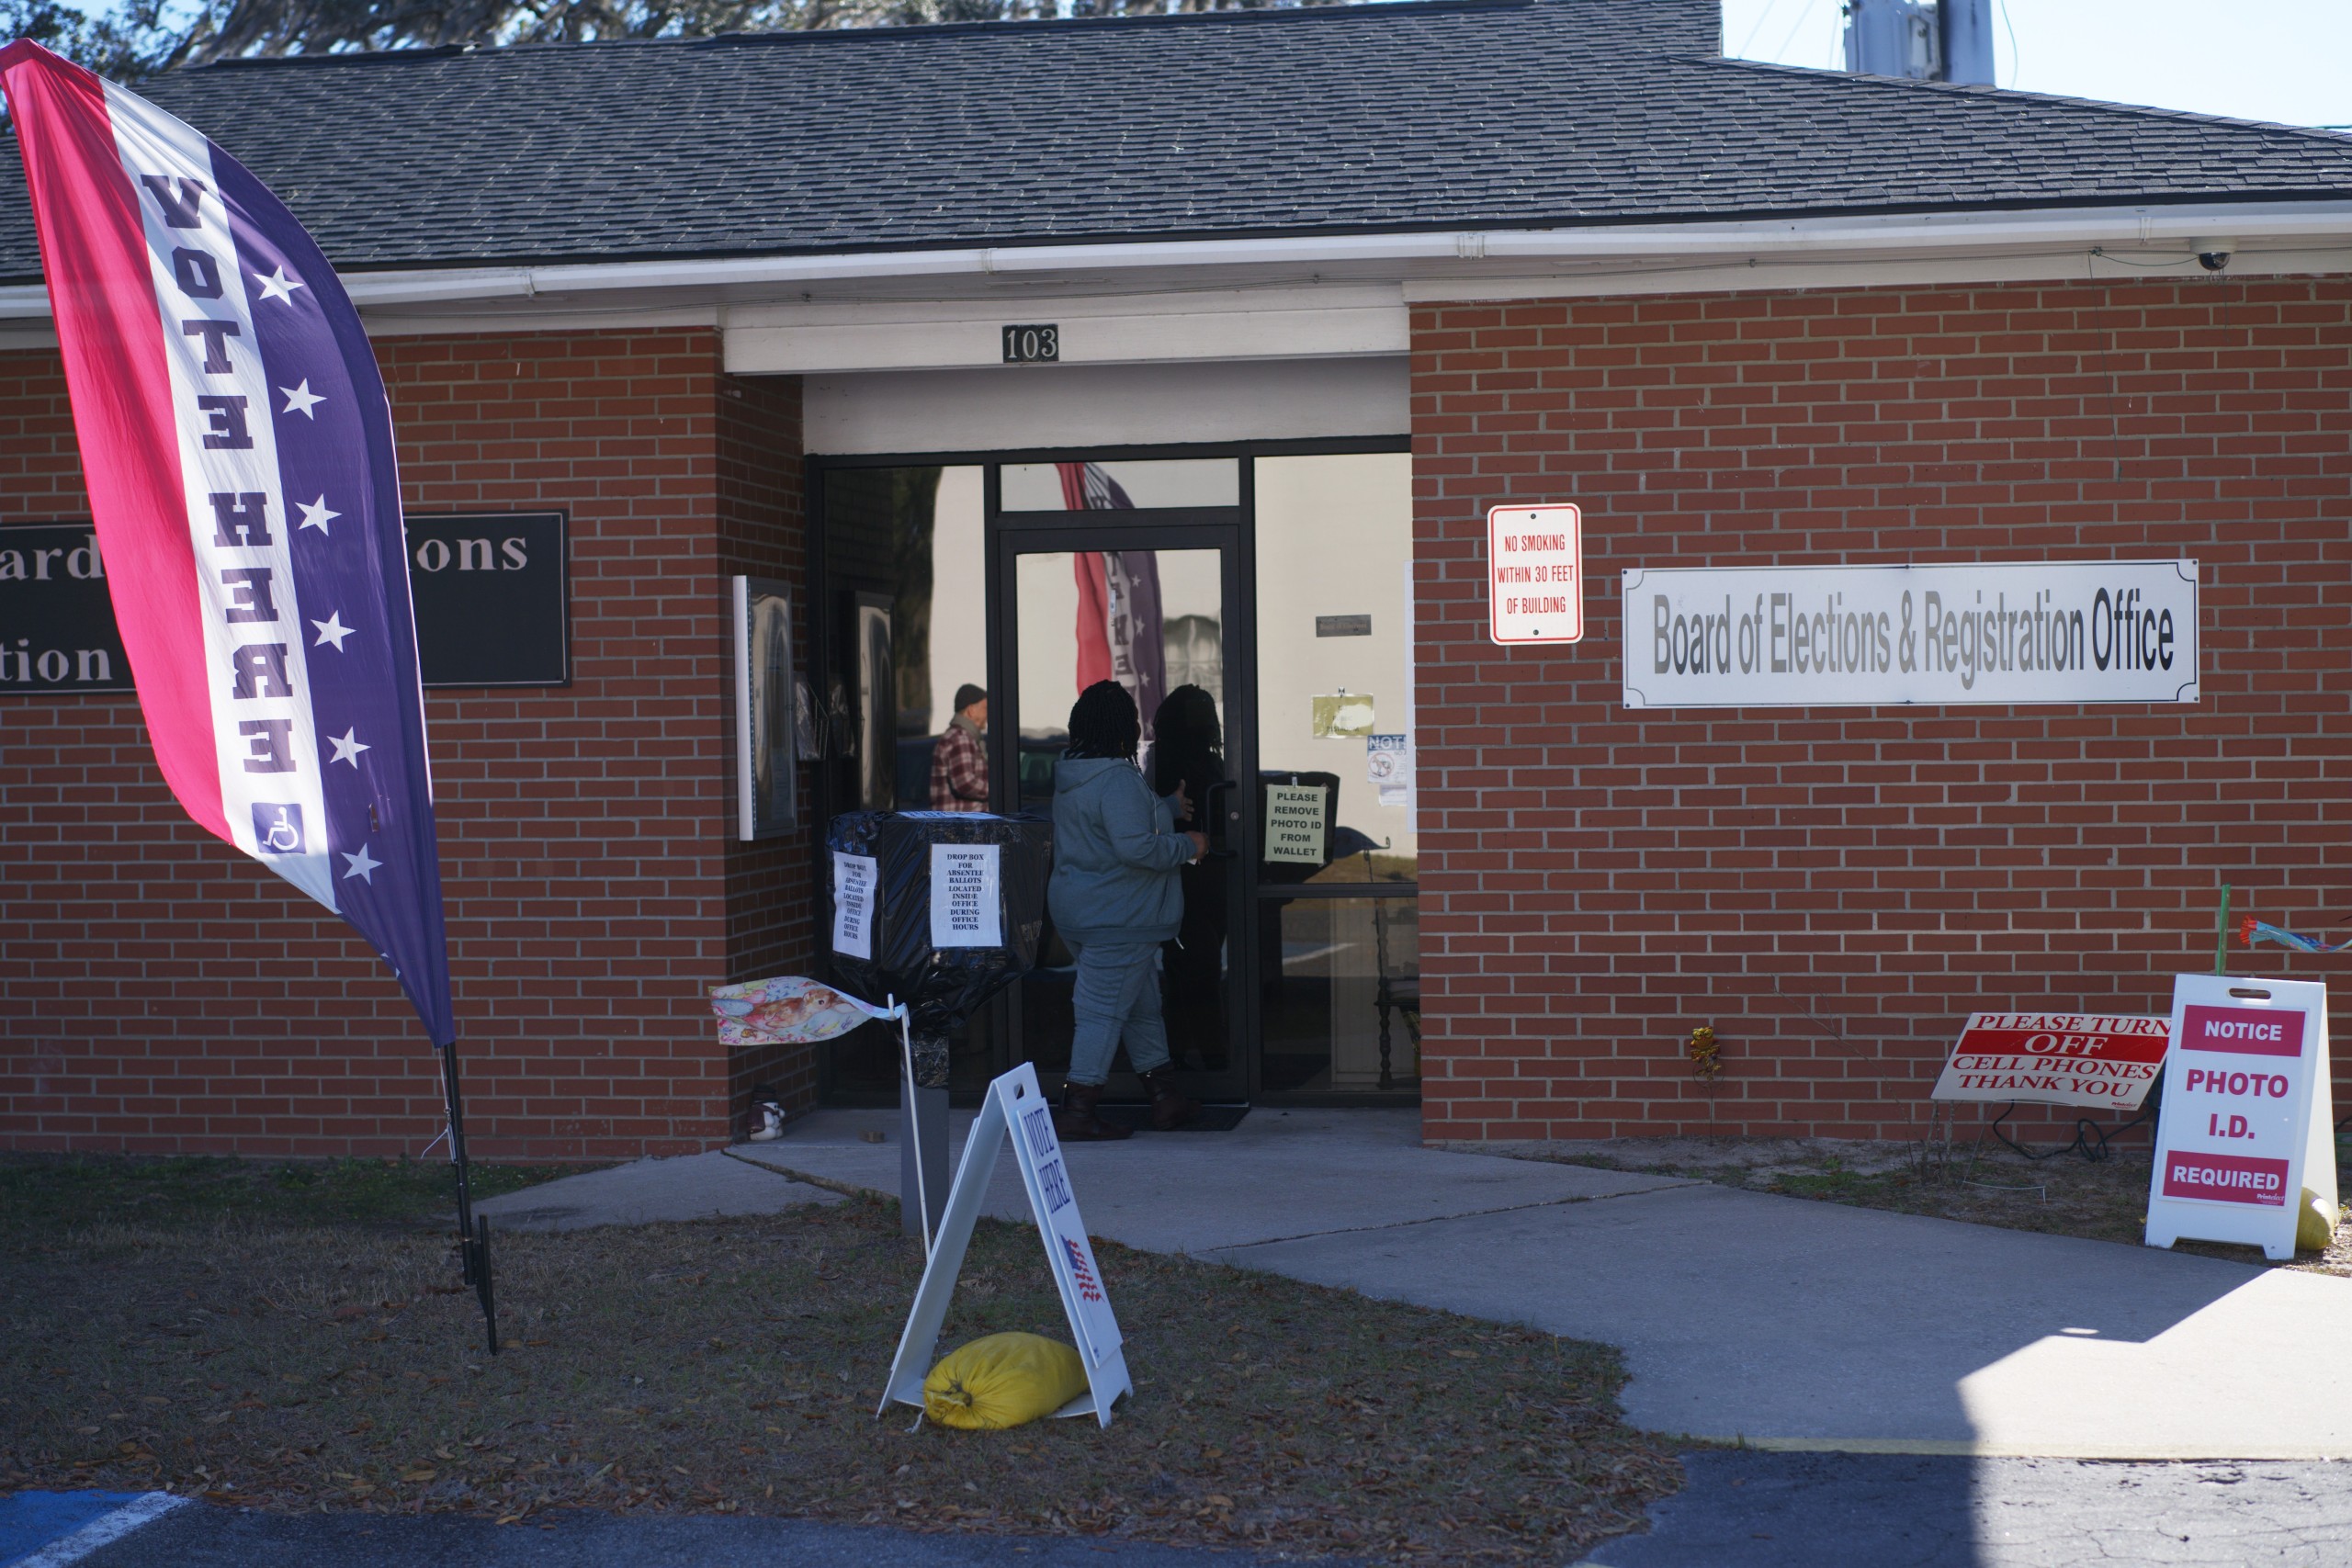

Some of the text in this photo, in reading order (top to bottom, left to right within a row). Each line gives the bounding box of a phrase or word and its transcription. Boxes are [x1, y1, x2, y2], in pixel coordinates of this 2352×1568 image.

[1007, 328, 1057, 358] 103
[1504, 534, 1566, 552] NO SMOKING
[1497, 565, 1574, 583] WITHIN 30 FEET
[1507, 596, 1566, 615] OF BUILDING
[1654, 586, 2174, 691] Board of Elections & Registration Office
[1277, 792, 1318, 802] PLEASE
[1274, 806, 1319, 816] REMOVE
[1271, 819, 1322, 829] PHOTO ID
[1280, 833, 1311, 842] FROM
[1273, 846, 1317, 856] WALLET
[843, 892, 864, 902] LOCATED
[844, 884, 864, 894] BALLOTS
[846, 908, 861, 917] OFFICE
[843, 923, 858, 932] OFFICE
[843, 931, 858, 940] HOURS
[1974, 1014, 2172, 1035] PLEASE TURN
[2205, 1020, 2283, 1042] NOTICE
[2024, 1033, 2109, 1055] OFF
[1952, 1055, 2156, 1080] CELL PHONES
[1958, 1074, 2133, 1098] THANK YOU
[2186, 1068, 2289, 1099] PHOTO
[1023, 1107, 1055, 1159] VOTE
[2209, 1112, 2256, 1140] I.D.
[1038, 1158, 1071, 1214] HERE
[2173, 1165, 2279, 1190] REQUIRED
[2256, 1192, 2286, 1201] Printelect
